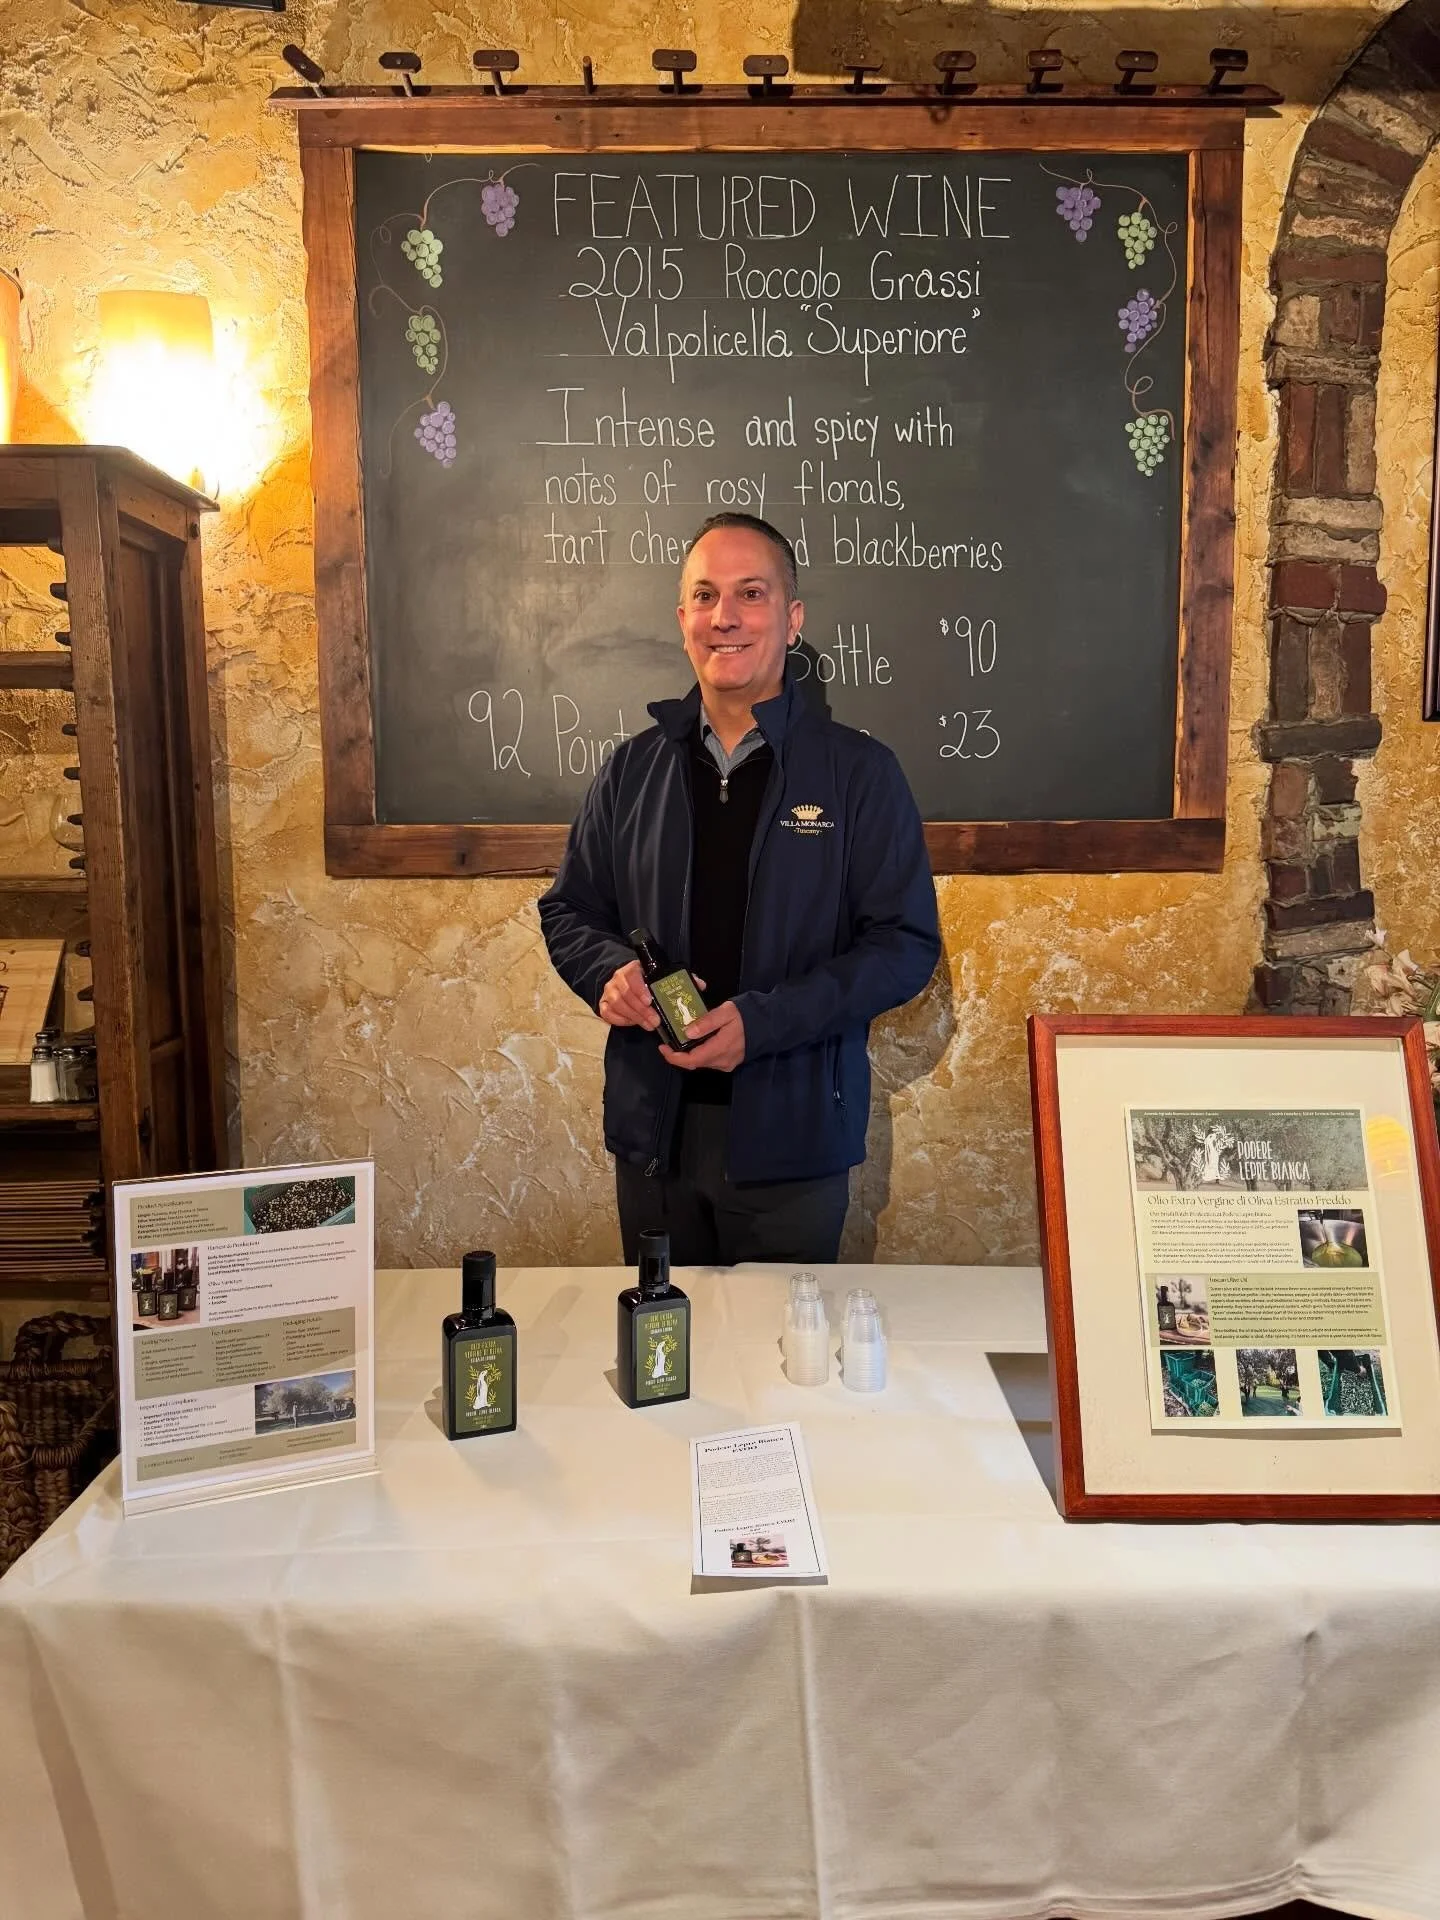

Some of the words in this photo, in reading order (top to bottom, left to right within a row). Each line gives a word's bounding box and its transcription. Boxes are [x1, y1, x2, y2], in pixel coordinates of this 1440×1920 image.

[554, 172, 816, 241] FEATURED
[848, 173, 1012, 239] WINE
[568, 246, 684, 301] 2015
[725, 242, 841, 301] Roccolo
[870, 250, 981, 301] Grassi
[594, 296, 794, 384] Valpolicella
[536, 386, 716, 449] Intense
[745, 395, 798, 448] and
[813, 411, 880, 461] spicy
[894, 405, 954, 448] with
[544, 456, 618, 506] notes
[643, 457, 678, 506] of
[705, 471, 766, 520] rosy
[793, 459, 906, 511] florals,
[543, 511, 609, 566] tart
[629, 510, 694, 566] cher
[832, 513, 1004, 572] blackberries
[787, 623, 894, 687] Bottle
[938, 615, 998, 677] $90
[468, 688, 532, 779] 92
[552, 694, 632, 777] Point
[937, 708, 1001, 759] $23
[780, 820, 800, 828] VILLA
[800, 820, 835, 828] MONARCA
[1147, 1196, 1169, 1206] Olio
[1170, 1196, 1197, 1206] Extra
[1197, 1196, 1236, 1209] Vergine
[1236, 1195, 1247, 1206] di
[1248, 1195, 1274, 1207] Oliva
[1274, 1195, 1315, 1206] Estratto
[1315, 1195, 1352, 1206] Freddo
[1271, 1161, 1311, 1181] BIANCA
